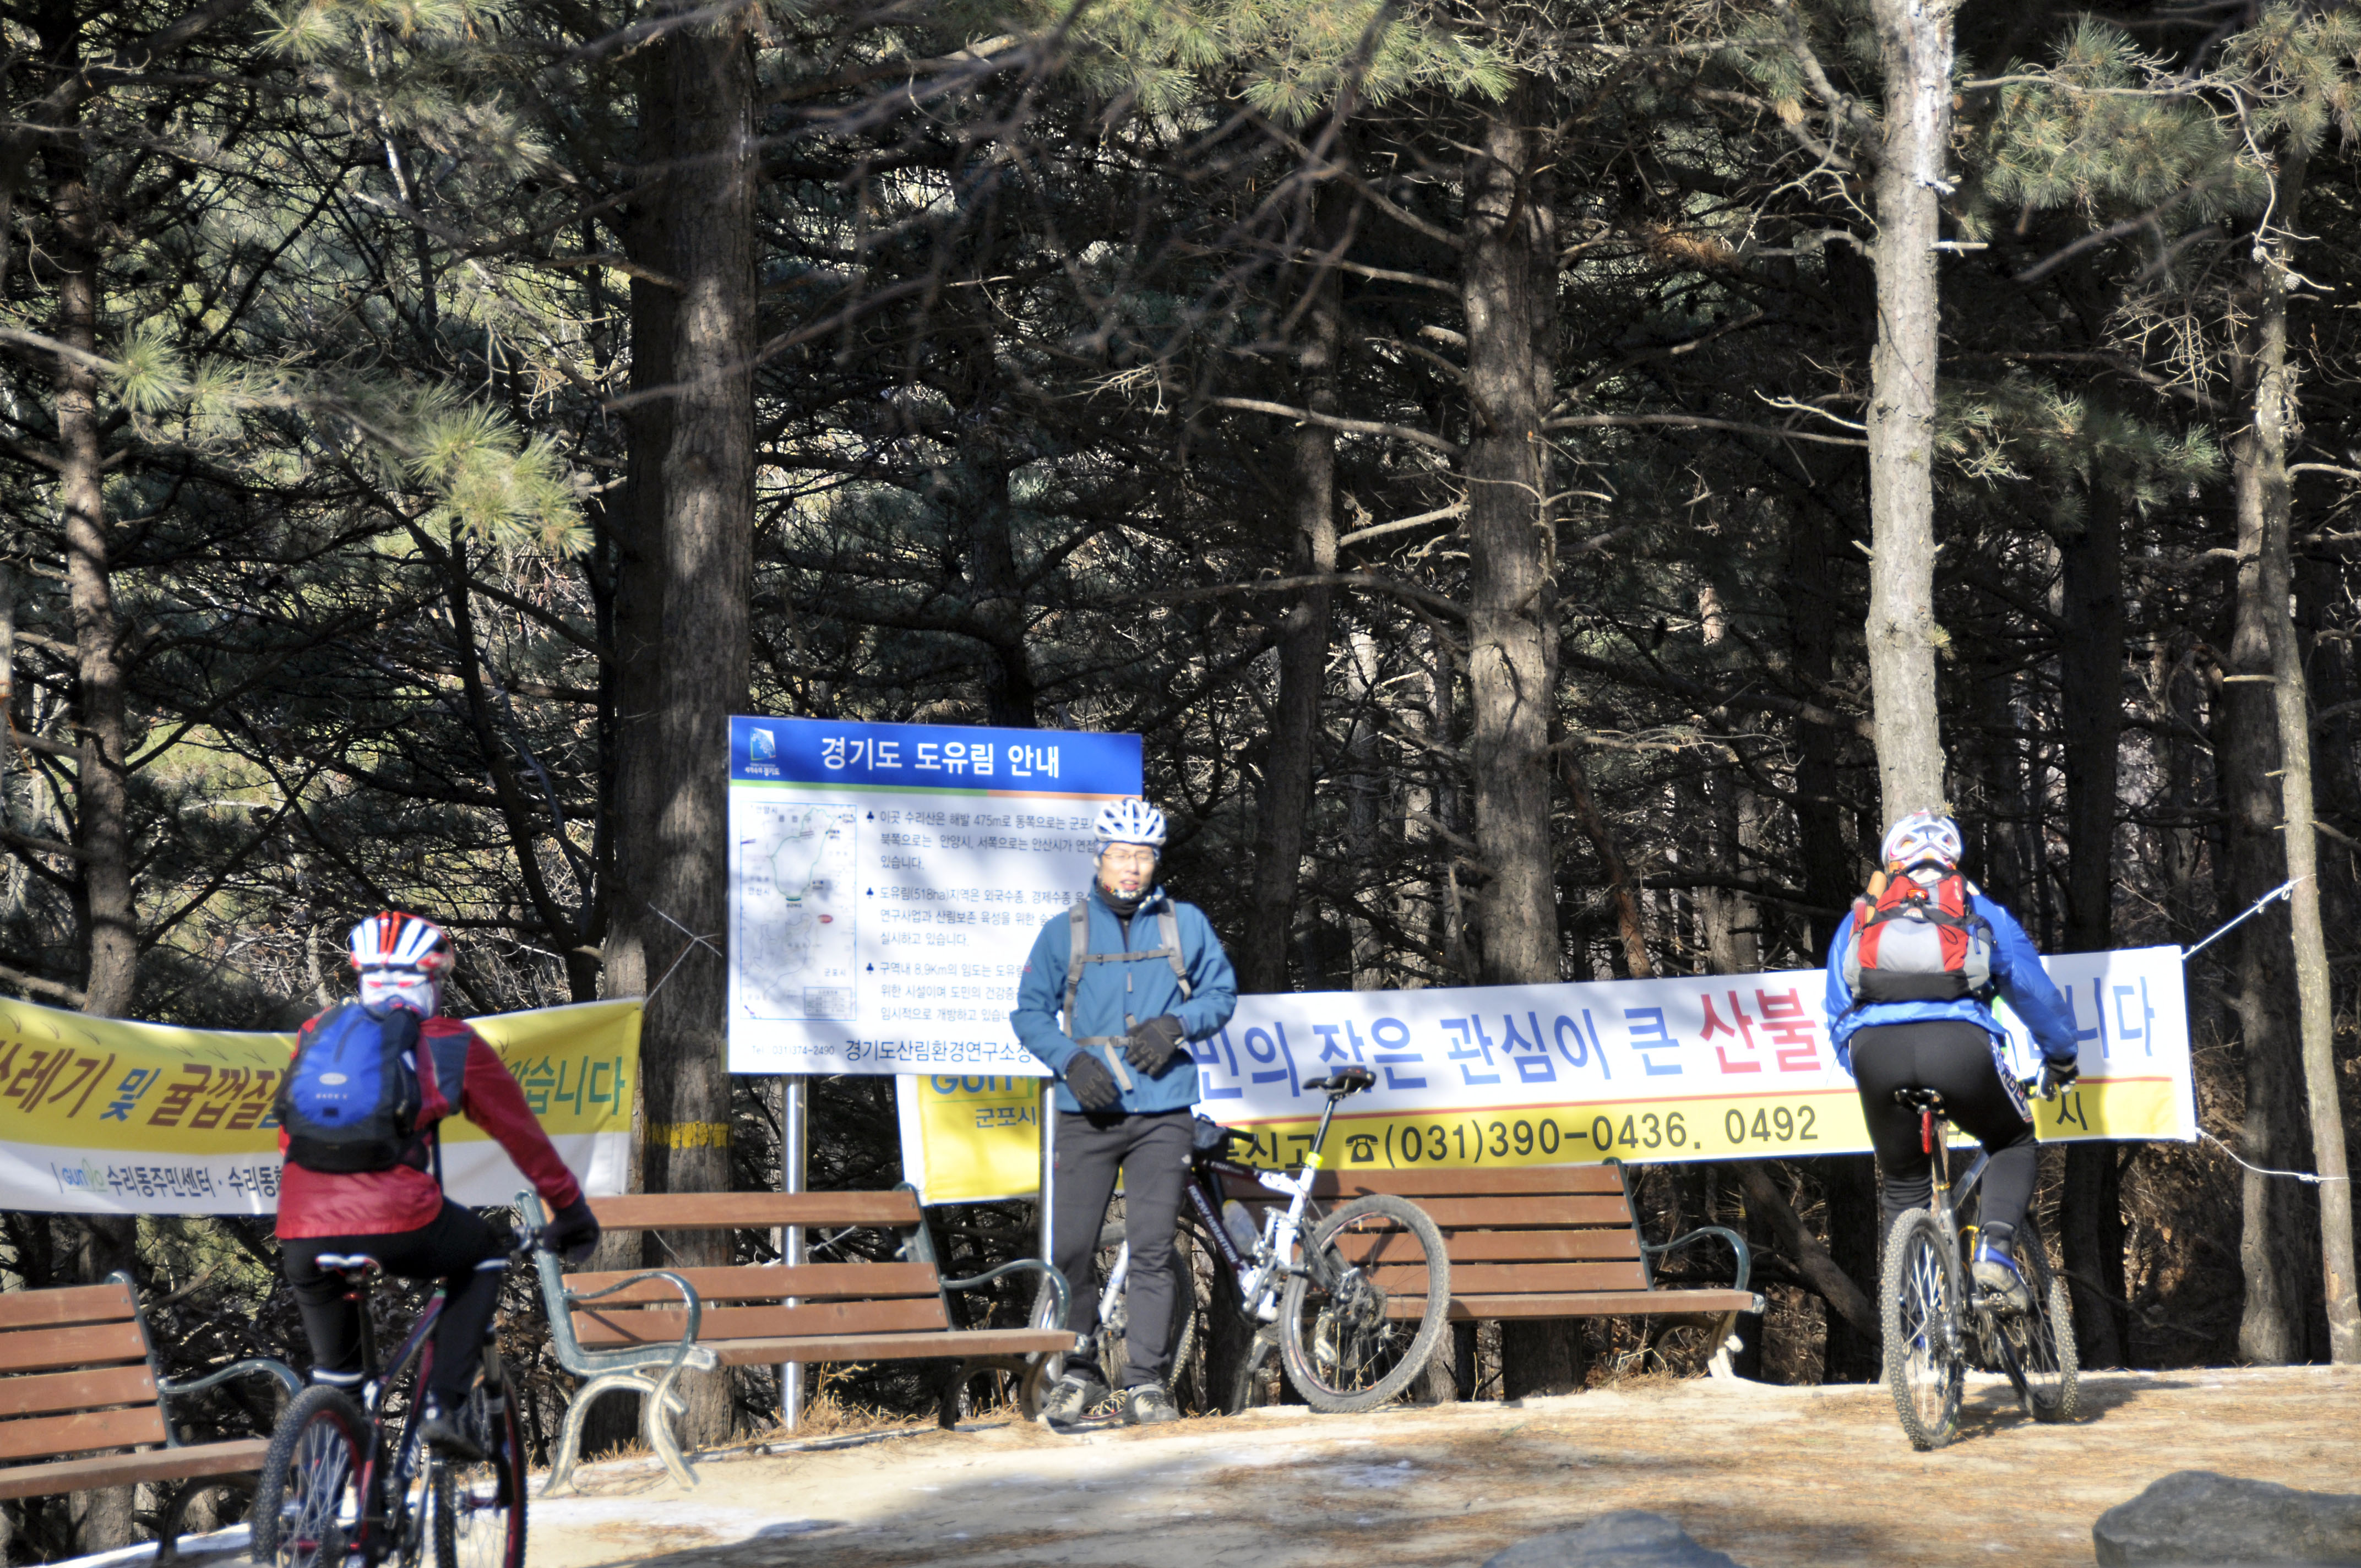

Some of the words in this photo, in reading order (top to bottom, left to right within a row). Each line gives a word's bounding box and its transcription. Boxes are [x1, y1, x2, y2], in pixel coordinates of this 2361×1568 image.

[822, 736, 903, 771] 경기도
[915, 742, 993, 775] 도유림
[1008, 743, 1059, 778] 안내
[880, 811, 900, 824] 이곳
[905, 811, 945, 826] 수리산은
[950, 813, 970, 827] 해발
[973, 813, 1012, 827] 475m로
[1016, 815, 1065, 830] 동쪽으로는
[880, 833, 932, 848] 북쪽으로는
[978, 836, 1028, 852] 서쪽으로는
[1032, 838, 1072, 853] 안산시가
[880, 856, 925, 870] 있습니다.
[880, 887, 980, 903] 도유림(518ha)지역은
[1032, 890, 1071, 905] 경제수종
[1075, 891, 1091, 903] 육
[880, 909, 932, 924] 연구사업과
[937, 910, 977, 925] 산림보존
[981, 911, 1011, 925] 육성을
[1015, 912, 1035, 925] 위한
[880, 932, 922, 945] 실시하고
[926, 932, 970, 947] 있습니다.
[880, 961, 911, 975] 구역내
[914, 963, 957, 976] 8.9Km의
[961, 963, 992, 977] 임도는
[880, 984, 901, 998] 위한
[905, 985, 947, 999] 시설이며
[951, 986, 981, 999] 도민의
[986, 987, 1019, 1000] 건강증
[880, 1007, 932, 1021] 임시적으로
[937, 1008, 977, 1022] 개방하고
[1313, 1017, 1428, 1093] 작은
[1440, 1008, 1612, 1086] 관심이
[1624, 1007, 1683, 1076] 큰
[1700, 988, 1831, 1075] 산불
[2026, 976, 2156, 1059] 니다
[99, 1068, 161, 1121] 및
[975, 1106, 1036, 1128] 군포시
[1724, 1105, 1818, 1144] 0492
[107, 1165, 216, 1197] 수리동주민센터
